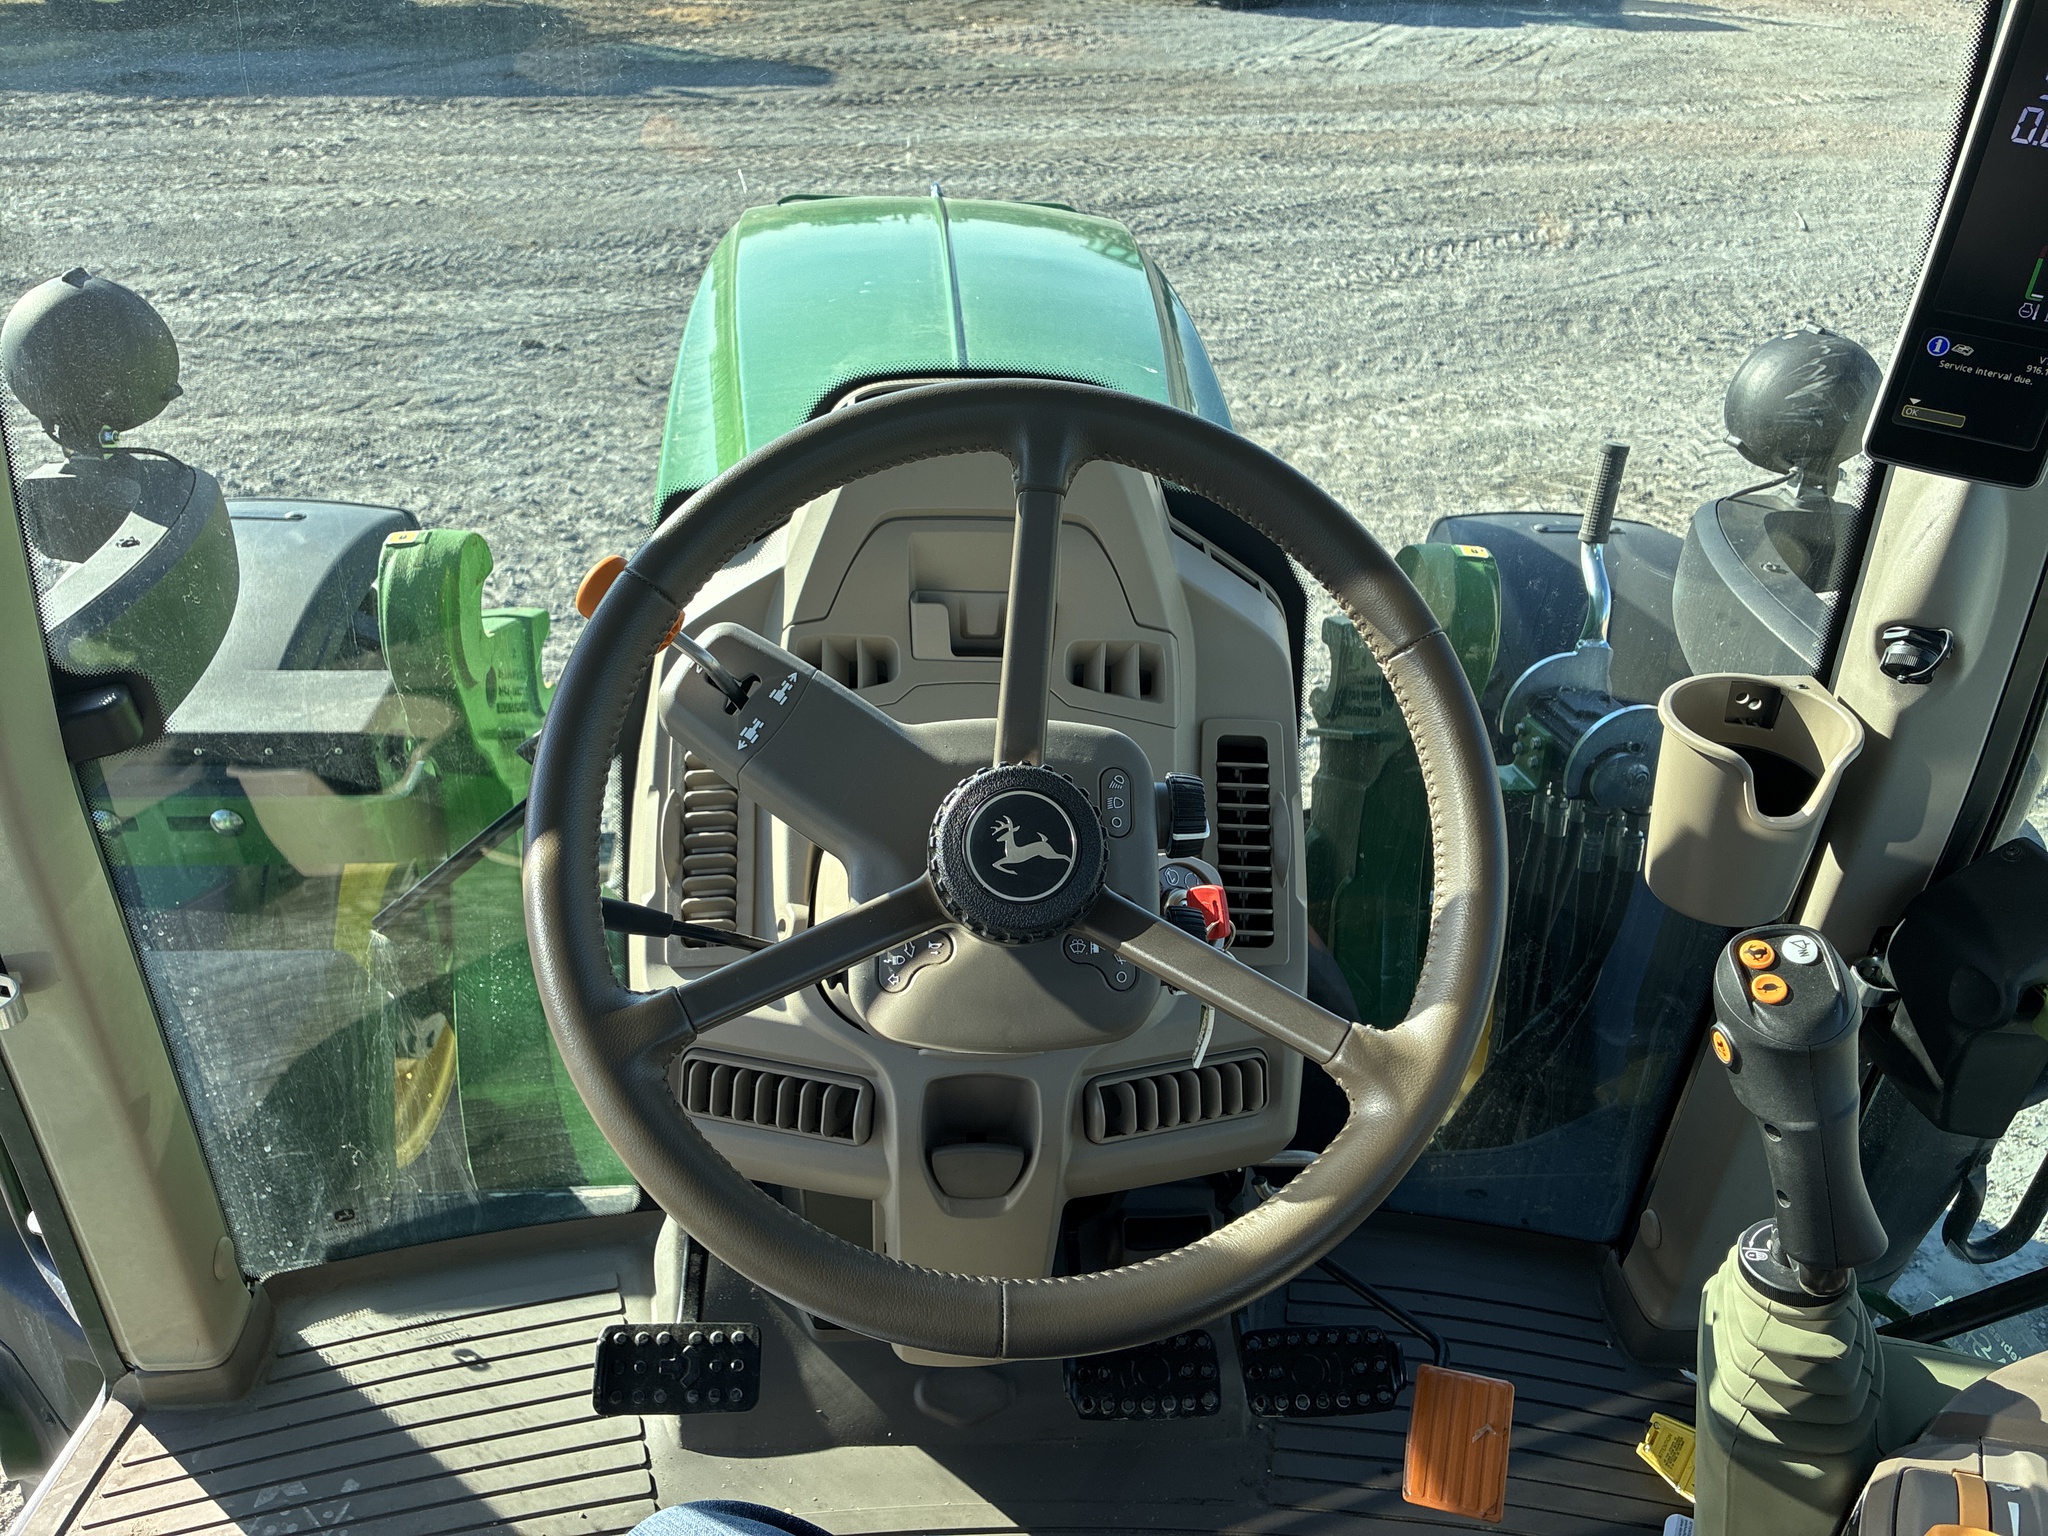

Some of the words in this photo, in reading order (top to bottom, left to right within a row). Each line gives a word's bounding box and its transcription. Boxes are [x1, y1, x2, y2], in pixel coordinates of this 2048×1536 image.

[1939, 360, 1973, 374] Service
[1975, 367, 2012, 381] interval
[2014, 375, 2033, 386] due.
[1905, 407, 1919, 417] OK
